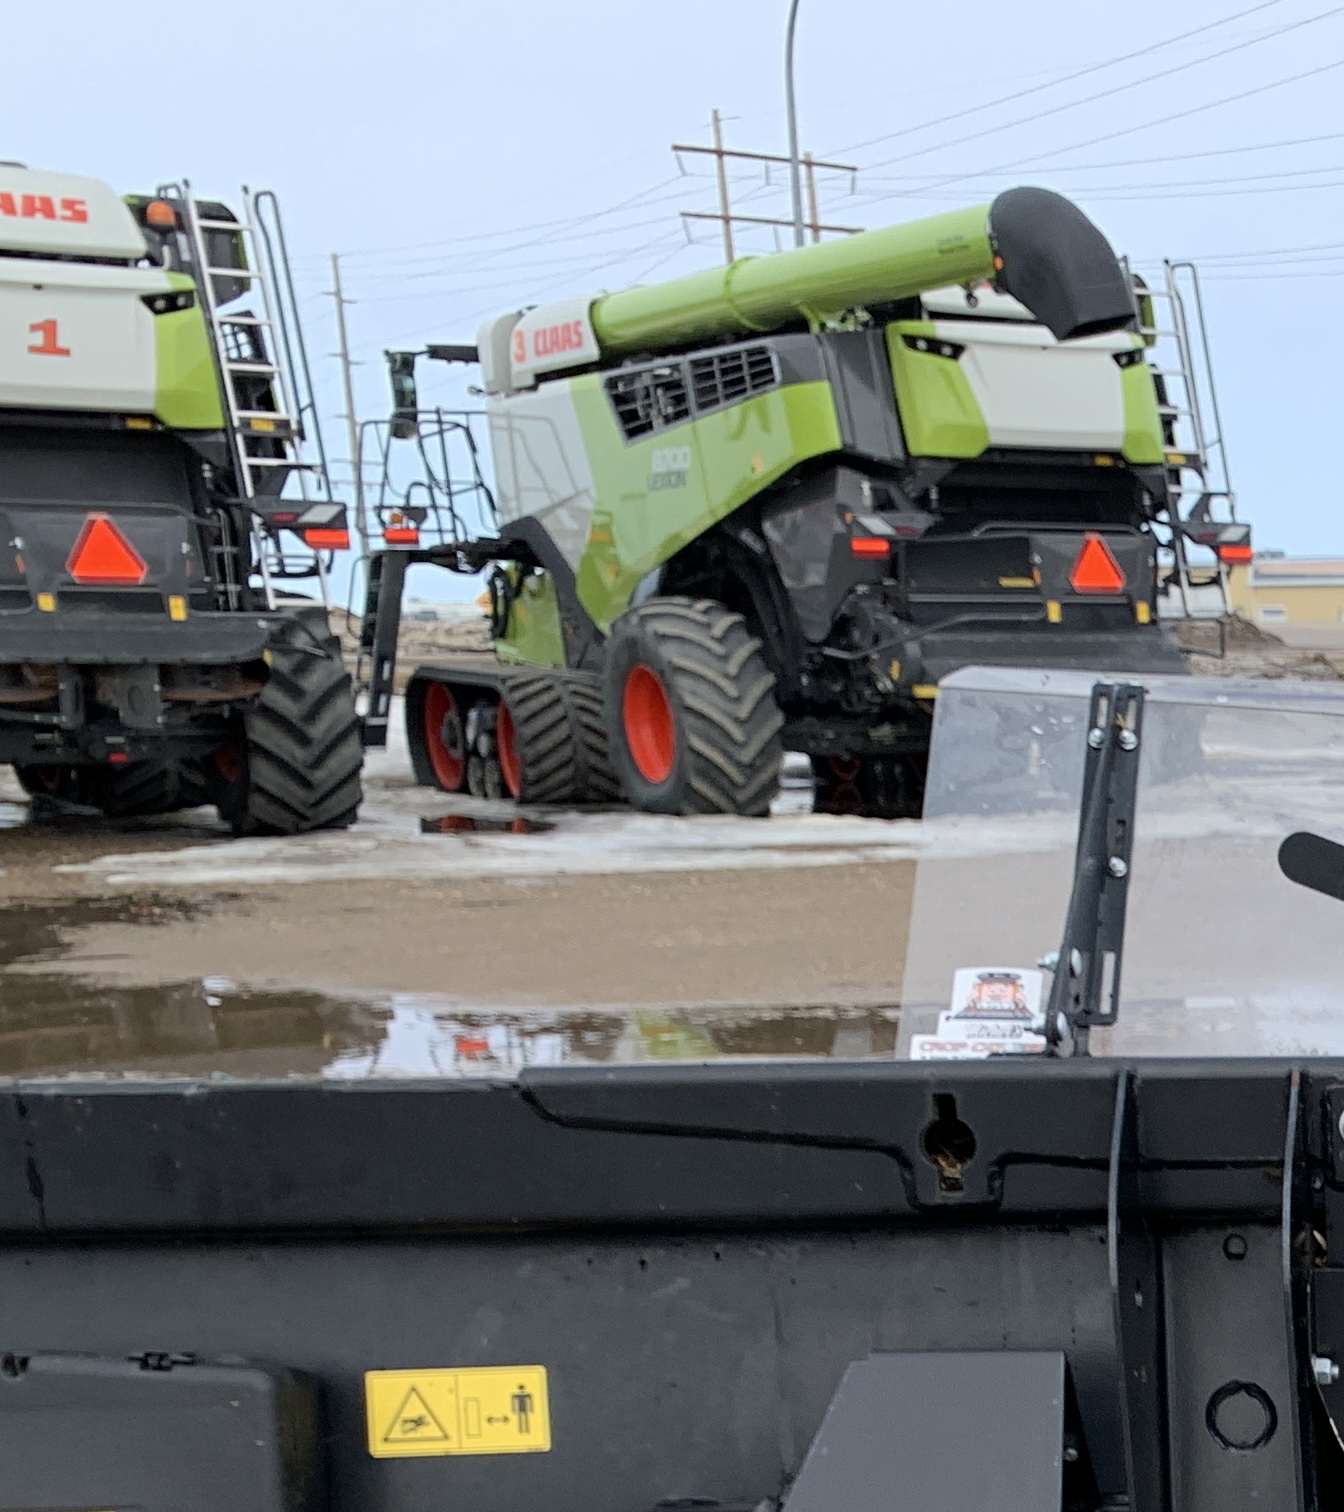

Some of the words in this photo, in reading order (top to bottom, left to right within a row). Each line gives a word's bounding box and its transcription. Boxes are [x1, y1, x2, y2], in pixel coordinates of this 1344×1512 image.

[27, 318, 71, 357] 1
[513, 330, 526, 364] 3
[533, 319, 584, 358] CLAAS
